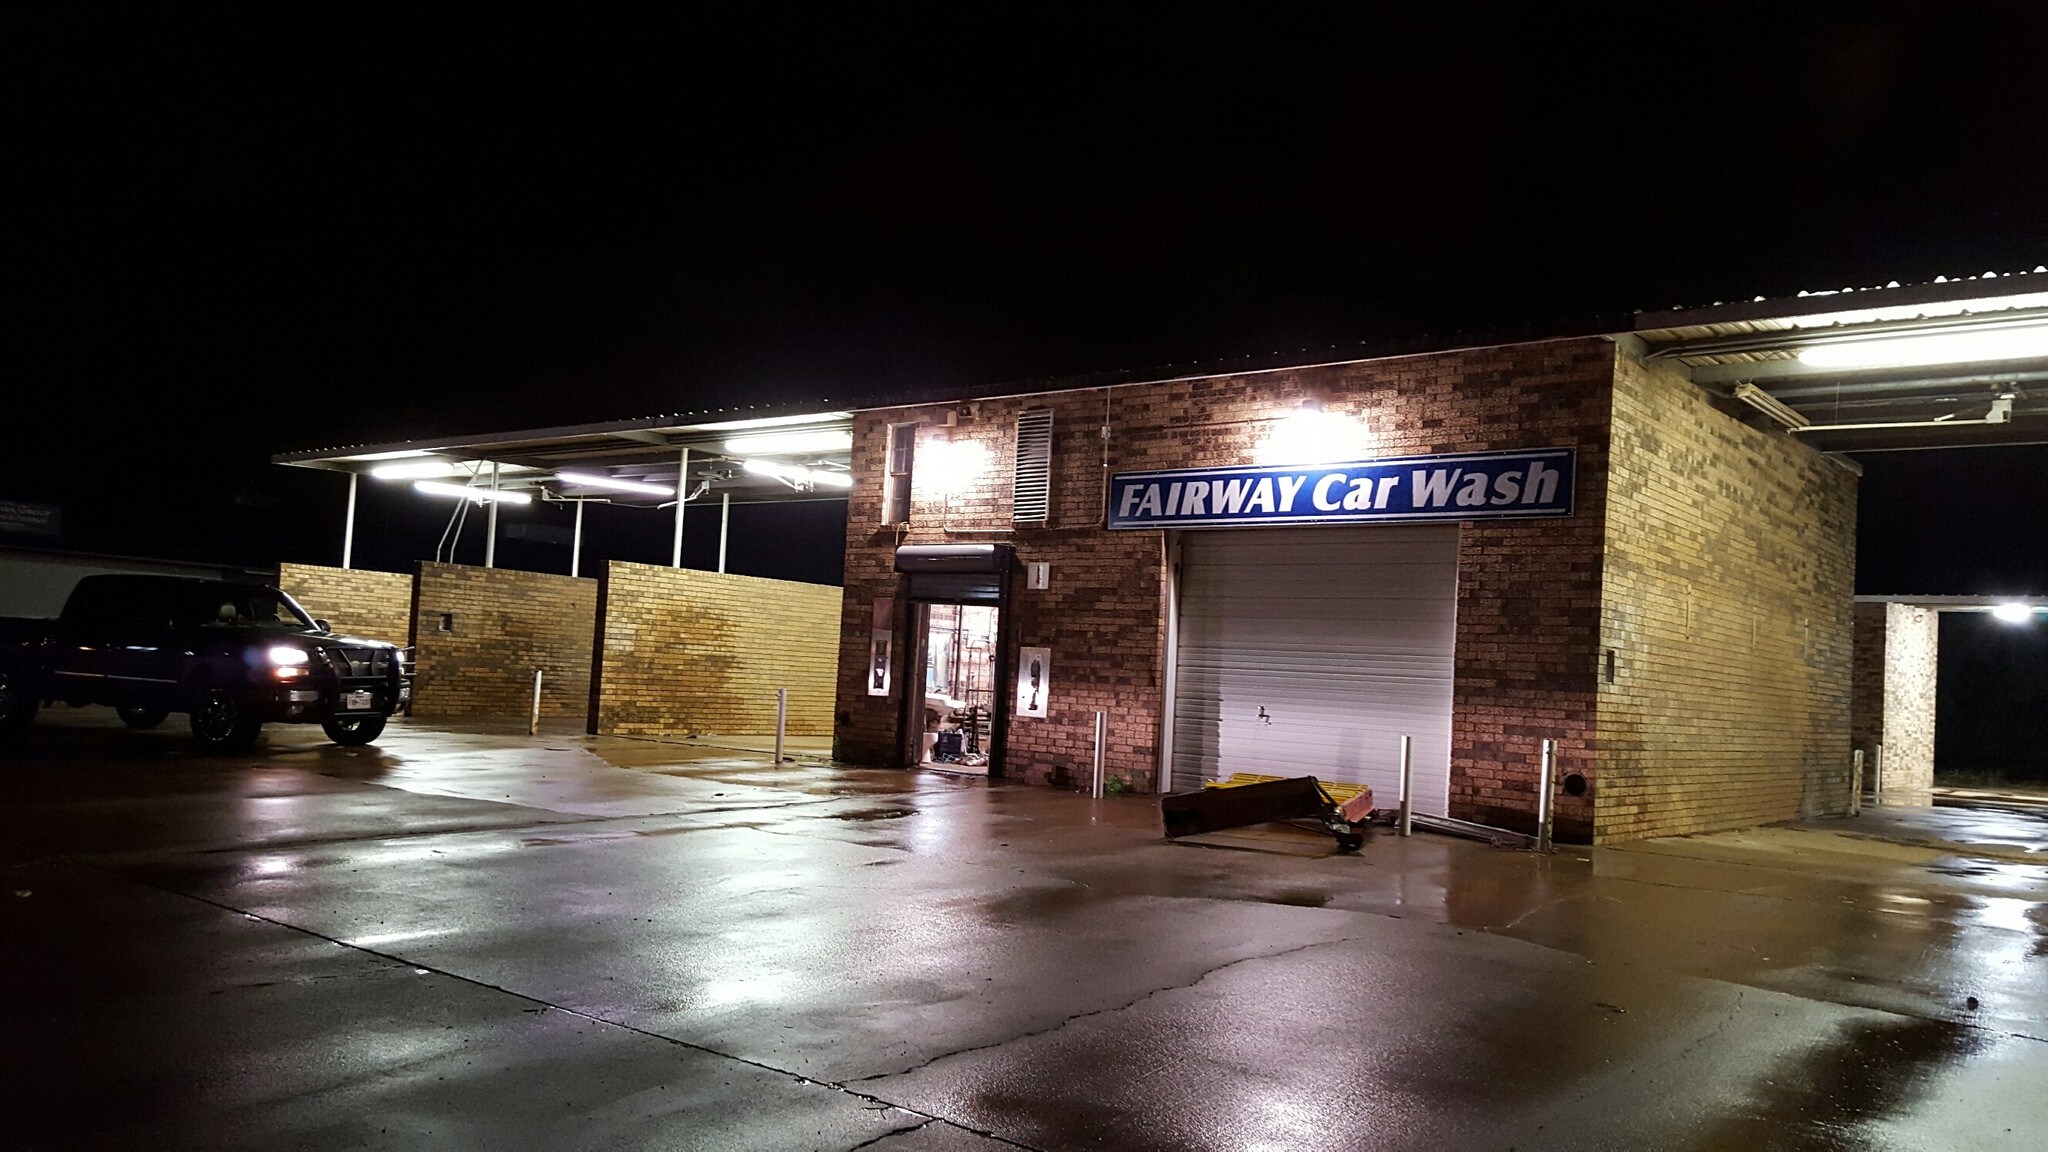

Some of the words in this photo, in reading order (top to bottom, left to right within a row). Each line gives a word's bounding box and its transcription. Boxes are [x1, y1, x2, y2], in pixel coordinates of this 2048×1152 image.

[1118, 474, 1307, 517] FAIRWAY
[1312, 473, 1400, 511] Car
[1411, 461, 1559, 508] Wash
